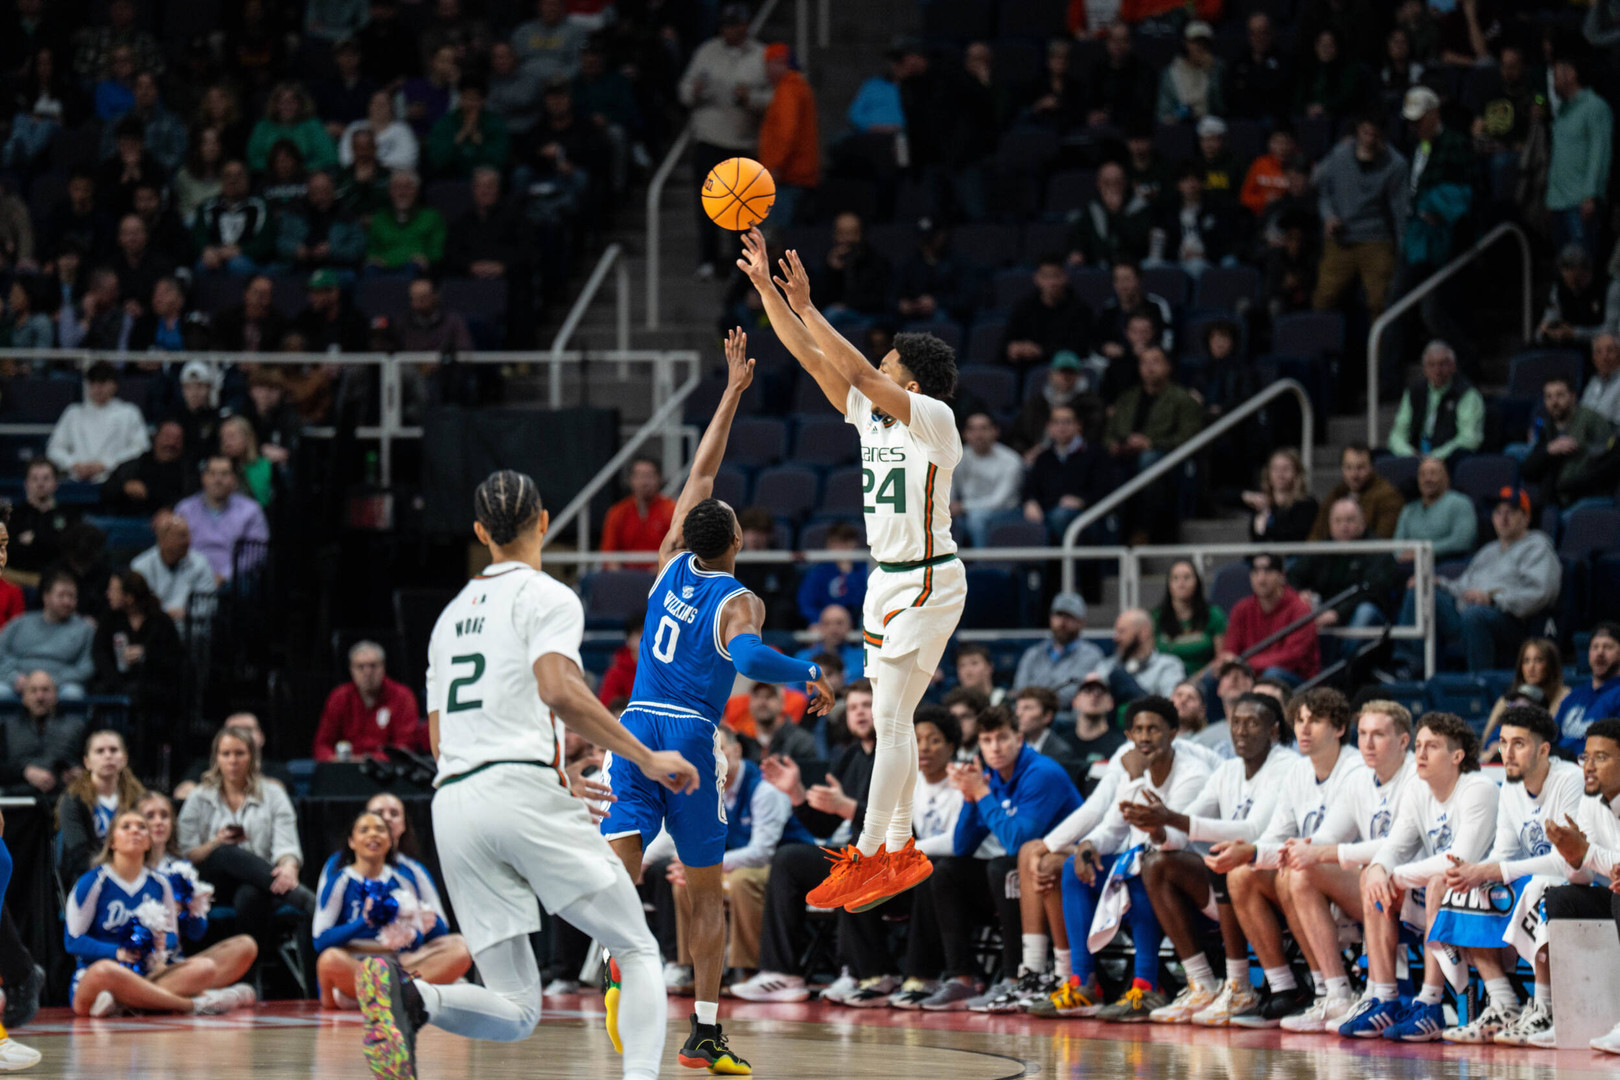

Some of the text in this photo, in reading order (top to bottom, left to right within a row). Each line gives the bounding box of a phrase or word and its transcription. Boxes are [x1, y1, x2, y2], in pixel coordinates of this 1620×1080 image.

[862, 467, 906, 514] 24
[652, 615, 681, 664] 0
[446, 652, 487, 714] 2
